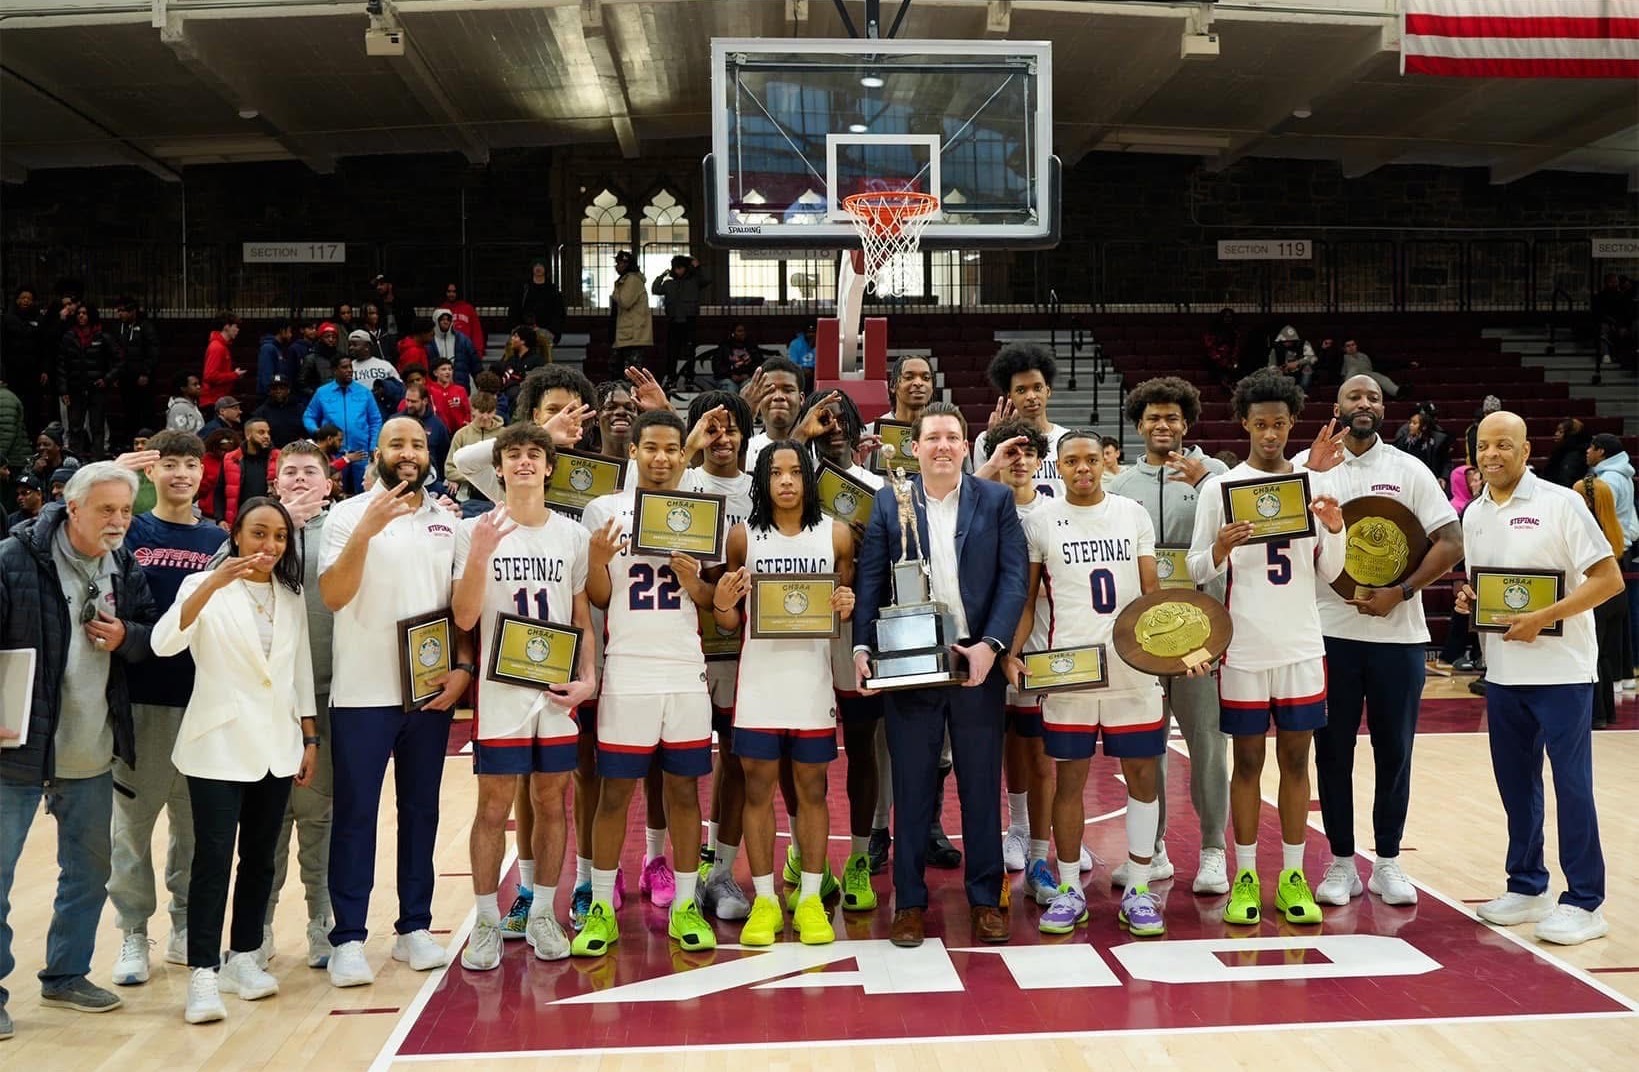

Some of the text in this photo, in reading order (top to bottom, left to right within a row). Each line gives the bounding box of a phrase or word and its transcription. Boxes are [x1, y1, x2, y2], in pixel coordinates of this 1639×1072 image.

[728, 226, 761, 234] SPALDING
[250, 245, 338, 259] SECTION 117
[1224, 242, 1305, 257] SECTION 119
[354, 367, 386, 380] INGS
[571, 459, 597, 470] CHSAA
[840, 482, 864, 500] CHSAA
[1253, 486, 1281, 495] CHSAA
[1371, 484, 1401, 493] STEPINAC
[666, 500, 695, 510] CHSAA
[1509, 516, 1540, 526] STEPINAC
[152, 548, 212, 563] STEPINA
[1061, 538, 1131, 565] STEPINAC
[153, 558, 204, 570] BASKETB
[755, 558, 827, 573] STEPINAC
[1266, 539, 1292, 585] 5
[493, 556, 564, 582] STEPINAC
[629, 562, 682, 611] 22
[782, 584, 811, 592] CHSAA
[1502, 578, 1532, 586] CHSAA
[1088, 567, 1117, 614] 0
[512, 587, 550, 620] 11
[527, 628, 554, 639] CHSAA
